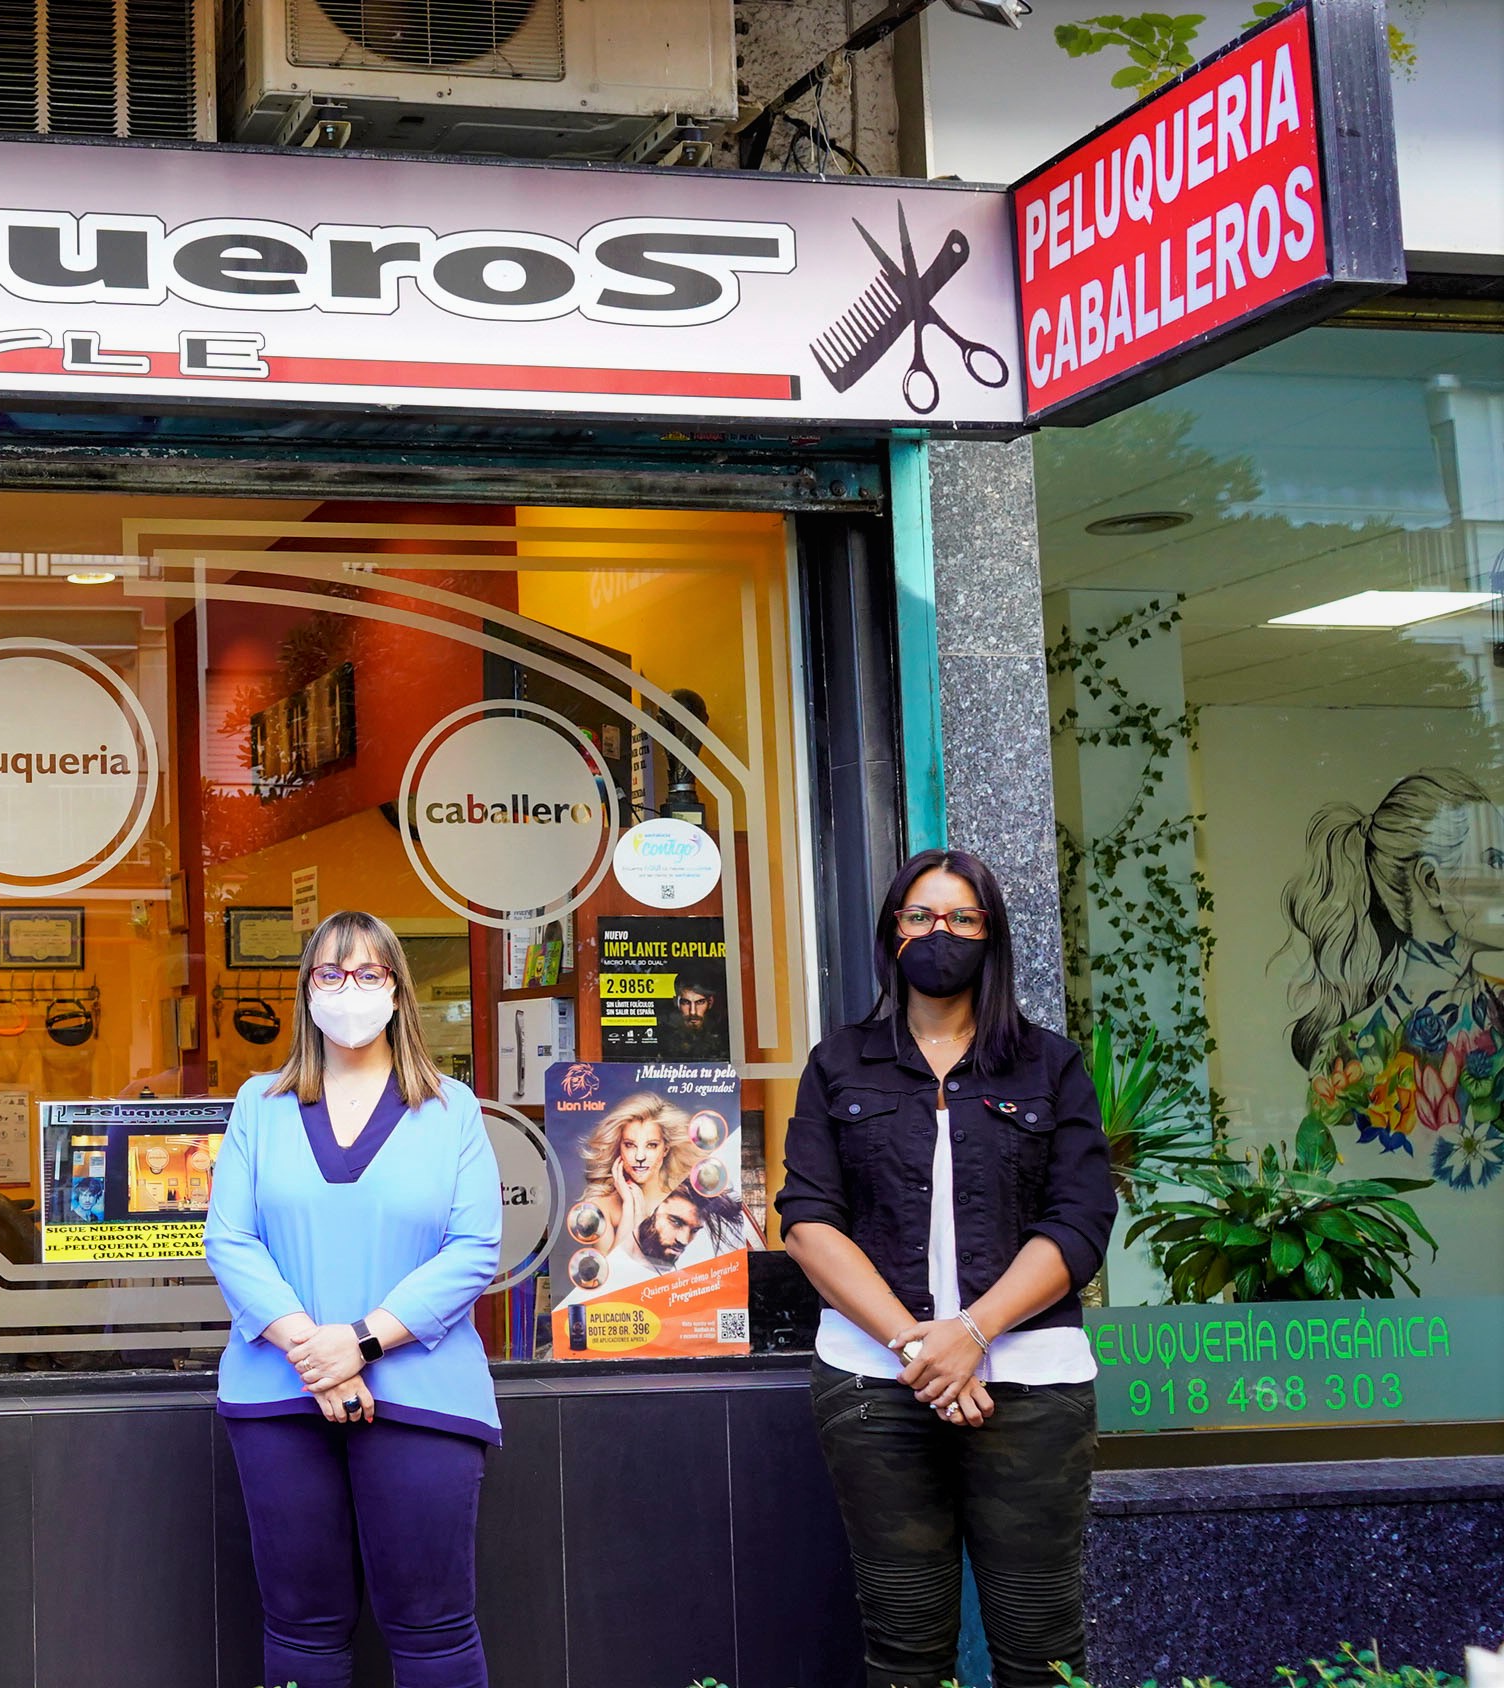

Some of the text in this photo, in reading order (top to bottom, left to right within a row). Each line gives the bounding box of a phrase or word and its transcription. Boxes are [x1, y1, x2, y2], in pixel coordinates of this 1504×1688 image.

[1023, 43, 1300, 281] PELUQUERIA
[1028, 165, 1315, 389] CABALLEROS
[426, 794, 592, 824] caballero
[604, 930, 629, 940] NUEVO
[604, 941, 726, 957] IMPLANTE CAPILAR
[606, 978, 654, 994] 2.985€
[636, 1064, 736, 1082] ¡Multiplica tu pelo
[667, 1082, 736, 1096] en 30 segundos!
[557, 1101, 607, 1111] Lion Hair
[90, 1224, 159, 1233] NUESTROS
[152, 1241, 170, 1249] DE
[137, 1250, 155, 1258] LU
[158, 1249, 203, 1257] HERAS
[671, 1277, 689, 1290] saber
[590, 1310, 645, 1323] APLICACIÓN 3€
[588, 1326, 606, 1336] BOTE
[607, 1326, 618, 1336] 28
[632, 1323, 650, 1335] 39€
[1285, 1307, 1450, 1362] ORGÁNICA
[1129, 1373, 1404, 1416] 918 468 303
